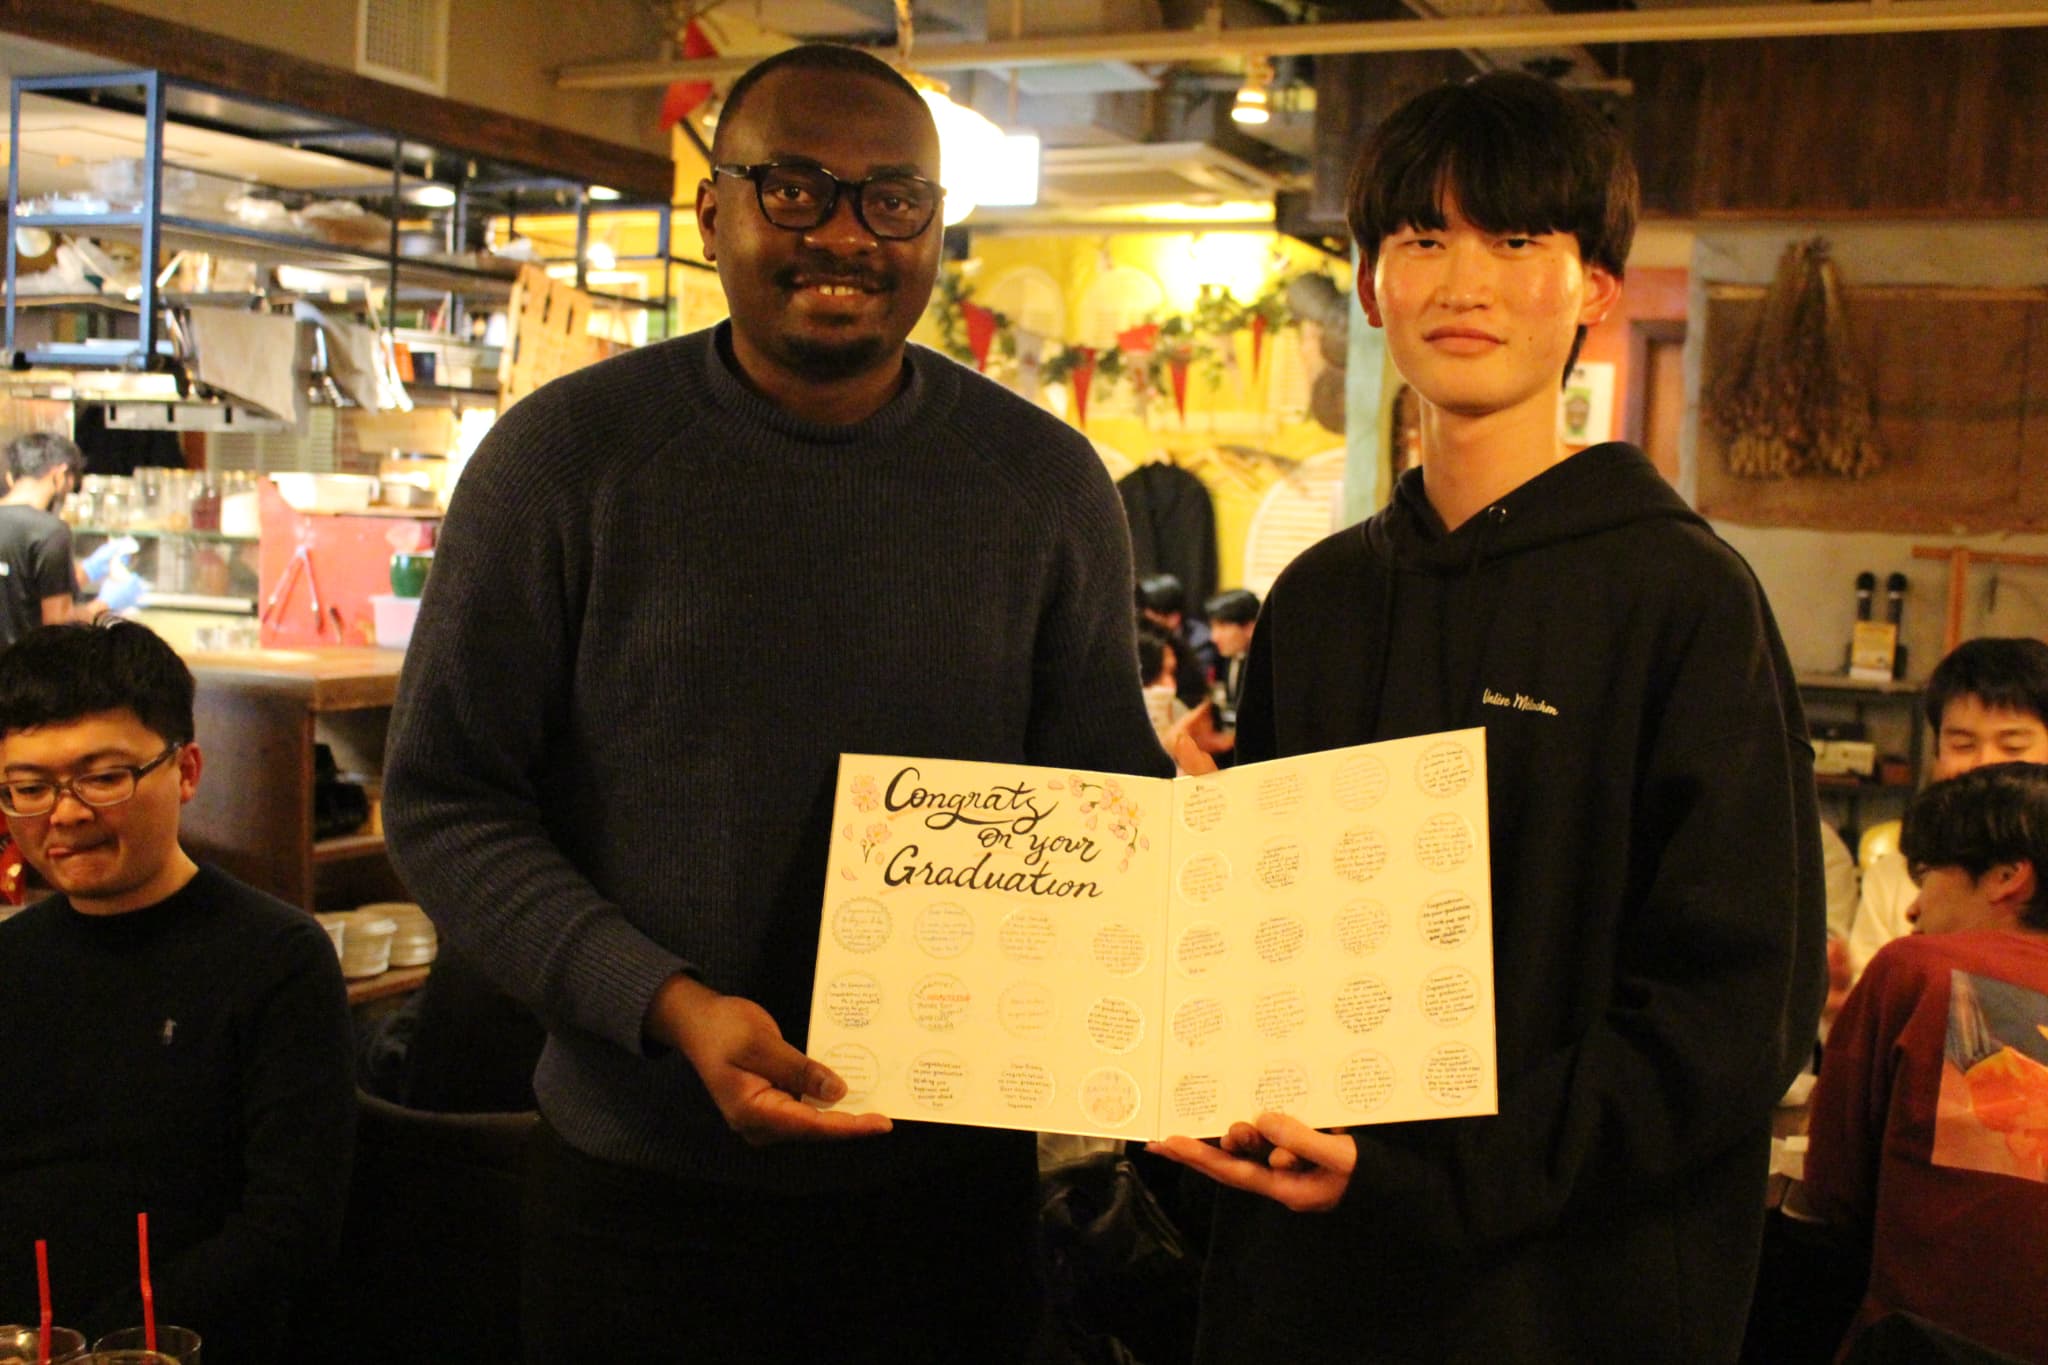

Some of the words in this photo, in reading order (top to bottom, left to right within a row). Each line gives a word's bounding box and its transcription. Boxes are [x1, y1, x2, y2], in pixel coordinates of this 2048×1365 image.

[884, 767, 1059, 834] Congrats
[884, 845, 1103, 898] Graduation
[978, 827, 1012, 848] on
[1024, 833, 1102, 864] your
